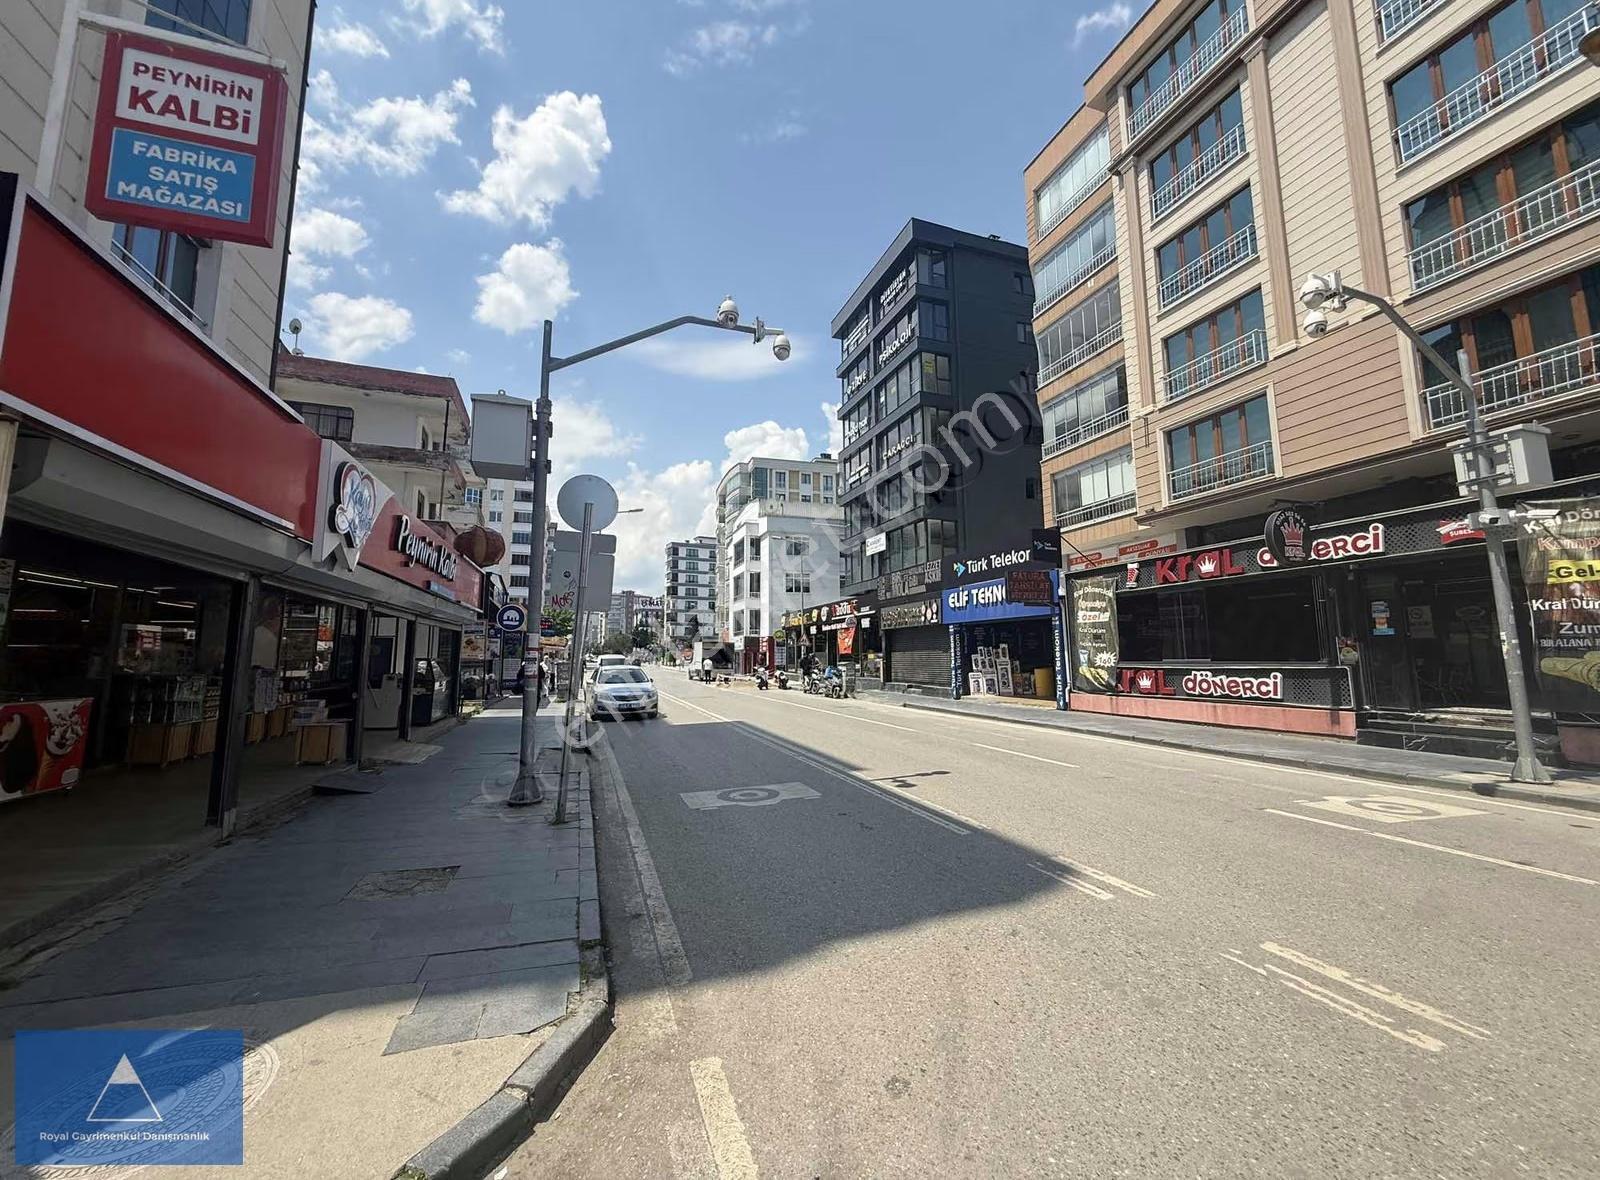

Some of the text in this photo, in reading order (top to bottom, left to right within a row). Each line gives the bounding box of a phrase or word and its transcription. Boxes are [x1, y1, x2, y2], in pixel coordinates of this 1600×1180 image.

[132, 61, 253, 102] PEYNİRİN
[128, 86, 251, 134] KALBİ
[132, 141, 237, 174] FABRİKA
[148, 166, 218, 194] SATIŞ
[116, 181, 242, 217] MAĞAZASI
[397, 515, 438, 568] Peynirin
[967, 558, 988, 574] Türk
[948, 587, 969, 608] ELİF
[970, 584, 1006, 606] TEKN
[1531, 597, 1567, 611] Kral
